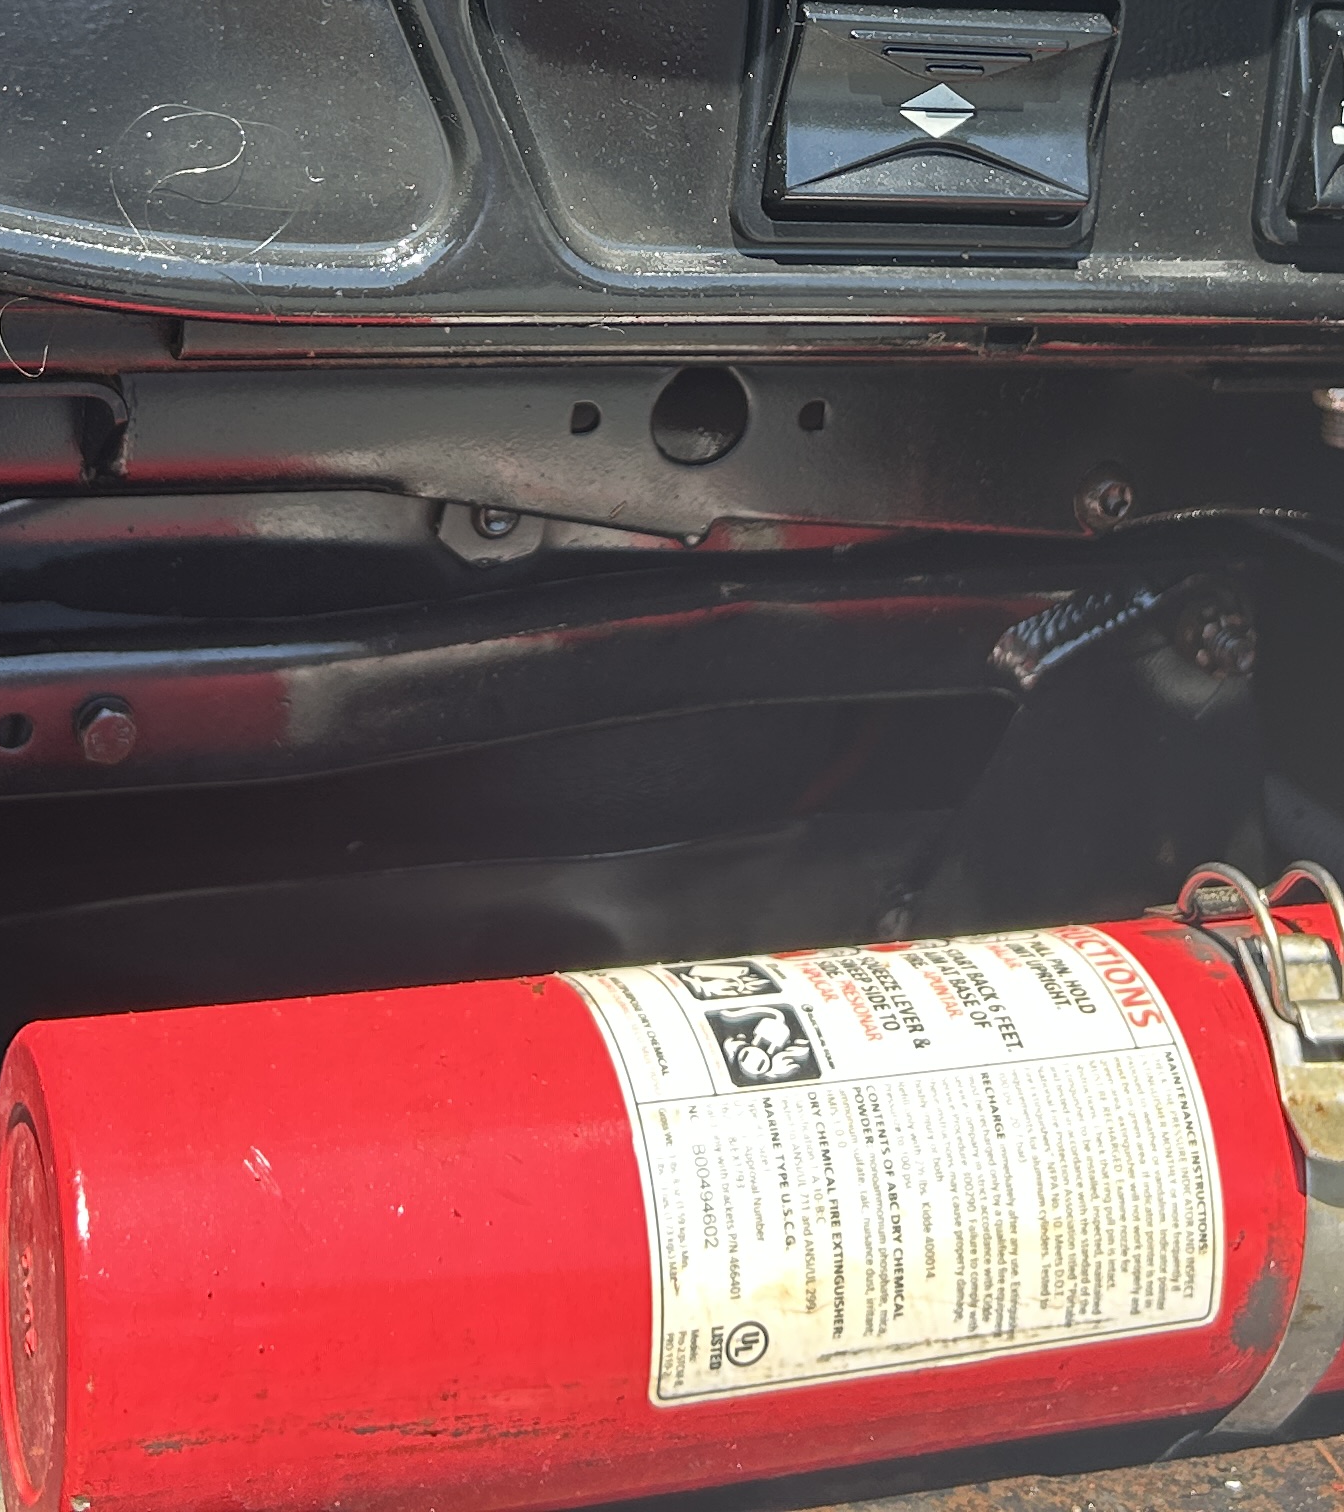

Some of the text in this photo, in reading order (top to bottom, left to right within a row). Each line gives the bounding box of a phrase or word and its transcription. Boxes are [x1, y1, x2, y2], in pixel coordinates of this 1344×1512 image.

[936, 964, 960, 977] AT
[947, 978, 980, 1007] BASE
[1024, 959, 1072, 1010] UPRIGHT.
[834, 958, 900, 1032] SWEEP SIDE TO
[835, 979, 882, 1041] PRESIONAR
[856, 956, 930, 1049] SQUEEZE LEVER &
[941, 948, 1024, 1052] START BACK 6 FEET.
[1065, 979, 1096, 1014] HOLD
[969, 1010, 991, 1029] OF
[646, 1030, 669, 1076] CHEMICAL
[980, 1072, 1006, 1140] RECHARGE
[1164, 1051, 1197, 1147] MAINTENANCE
[762, 1096, 795, 1251] MARINE TYPE U.S.C.G.
[1047, 1161, 1058, 1190] NFPA
[752, 1197, 765, 1241] Number
[799, 1192, 810, 1210] 711
[807, 1091, 844, 1340] DRY CHEMICAL FIRE EXTINGUISHER:
[865, 1084, 904, 1320] CONTENTS OF ABC DRY CHEMICAL
[921, 1201, 932, 1233] Kidde
[717, 1155, 740, 1300] with brackets P/N 466401
[801, 1215, 812, 1236] and
[1185, 1230, 1194, 1255] AND
[803, 1238, 816, 1285] ANSI/UL
[710, 1325, 723, 1370] LISTED
[733, 1330, 759, 1357] UL
